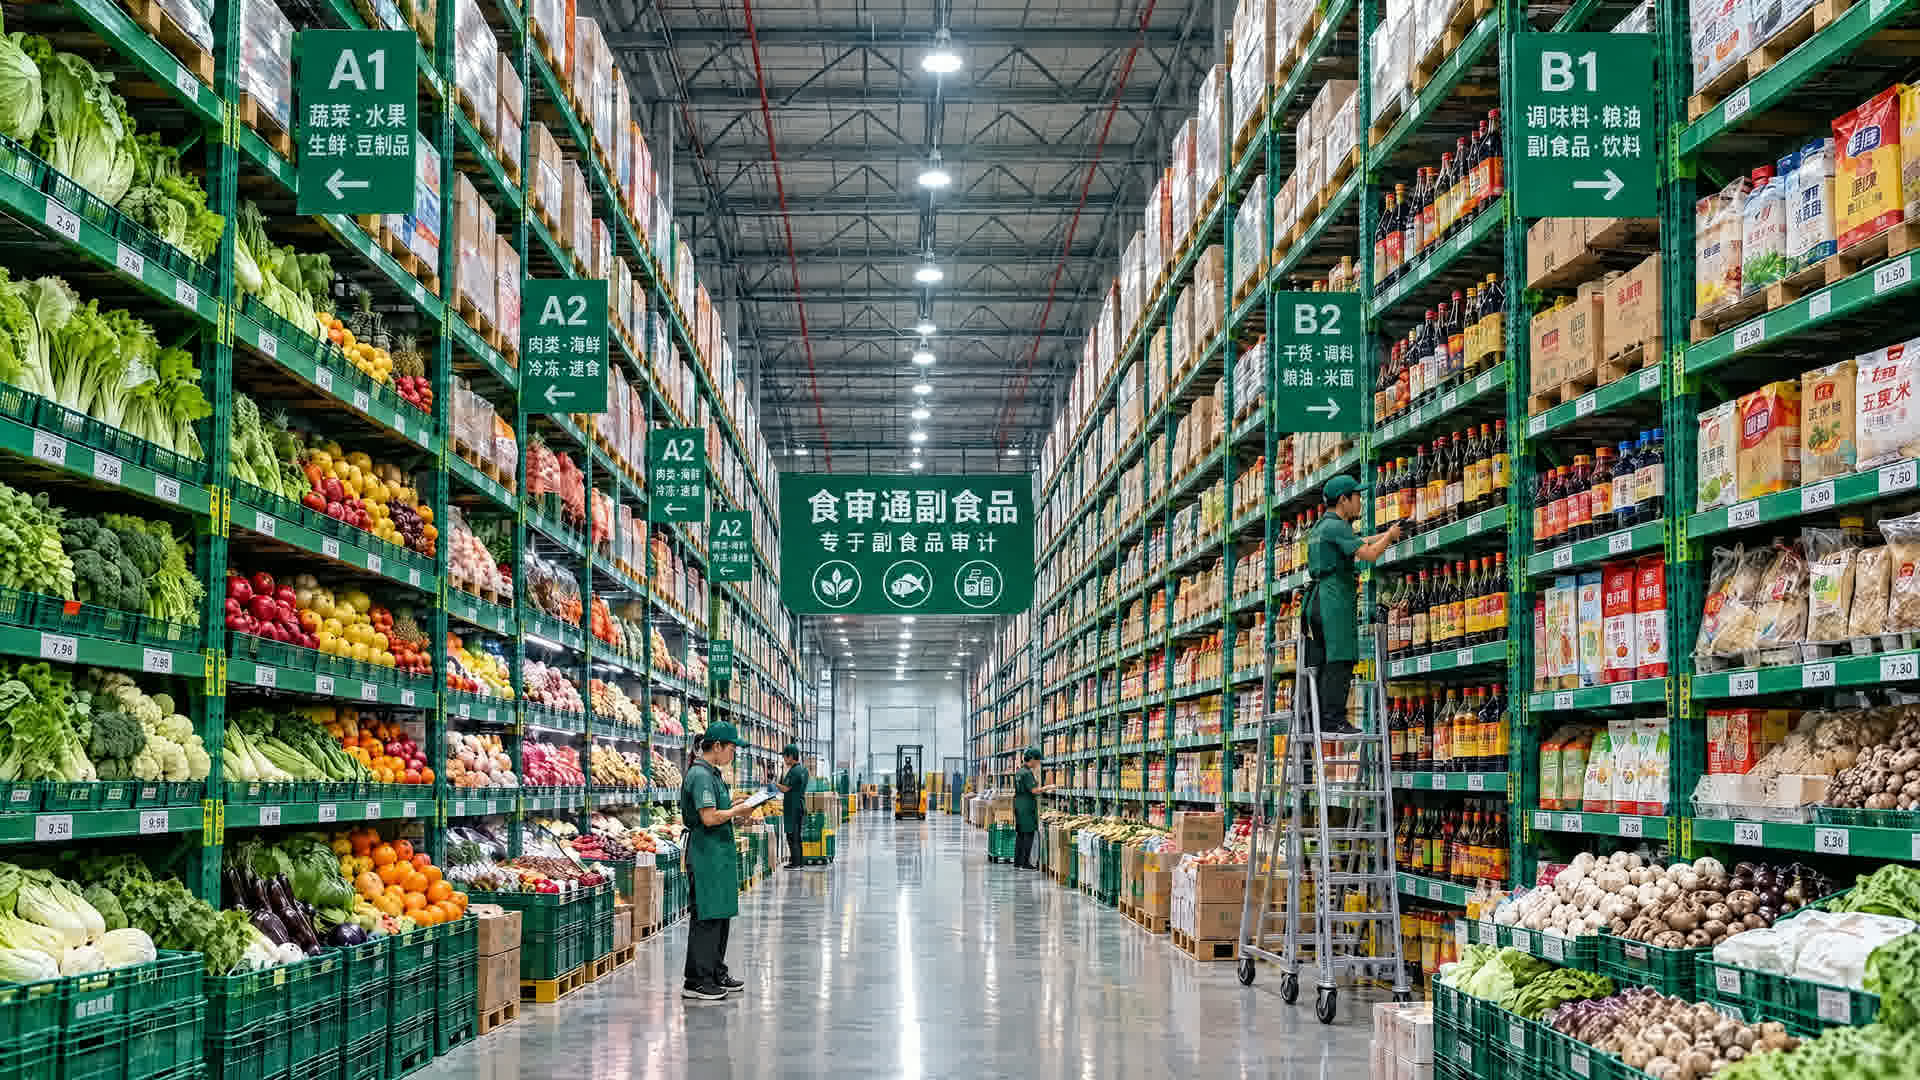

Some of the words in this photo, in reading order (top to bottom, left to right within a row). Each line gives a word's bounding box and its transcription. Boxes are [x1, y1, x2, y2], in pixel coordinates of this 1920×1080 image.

[328, 49, 385, 90] A1
[1542, 50, 1598, 92] B1
[309, 103, 407, 128] 蔬菜·水果
[1526, 104, 1641, 129] 调味料·粮油
[307, 133, 410, 157] 生鲜·豆制品
[1526, 135, 1641, 158] 副食品·饮料
[57, 215, 76, 235] 2.90
[539, 295, 588, 326] A2
[1295, 303, 1341, 335] B2
[528, 336, 601, 354] 肉类·海鲜
[1283, 343, 1354, 364] 干货·调料
[528, 360, 601, 378] 冷冻·速食
[1283, 367, 1355, 388] 粮油·米面
[662, 439, 695, 461] A2
[1889, 470, 1911, 486] 7.50
[807, 488, 1018, 524] 食审通副食品
[1735, 509, 1755, 522] 12.90
[717, 520, 742, 537] A2
[819, 531, 998, 553] 专于副食品审计
[1811, 671, 1830, 681] 7.30
[1890, 662, 1912, 674] 7.30
[48, 823, 69, 834] 9.50
